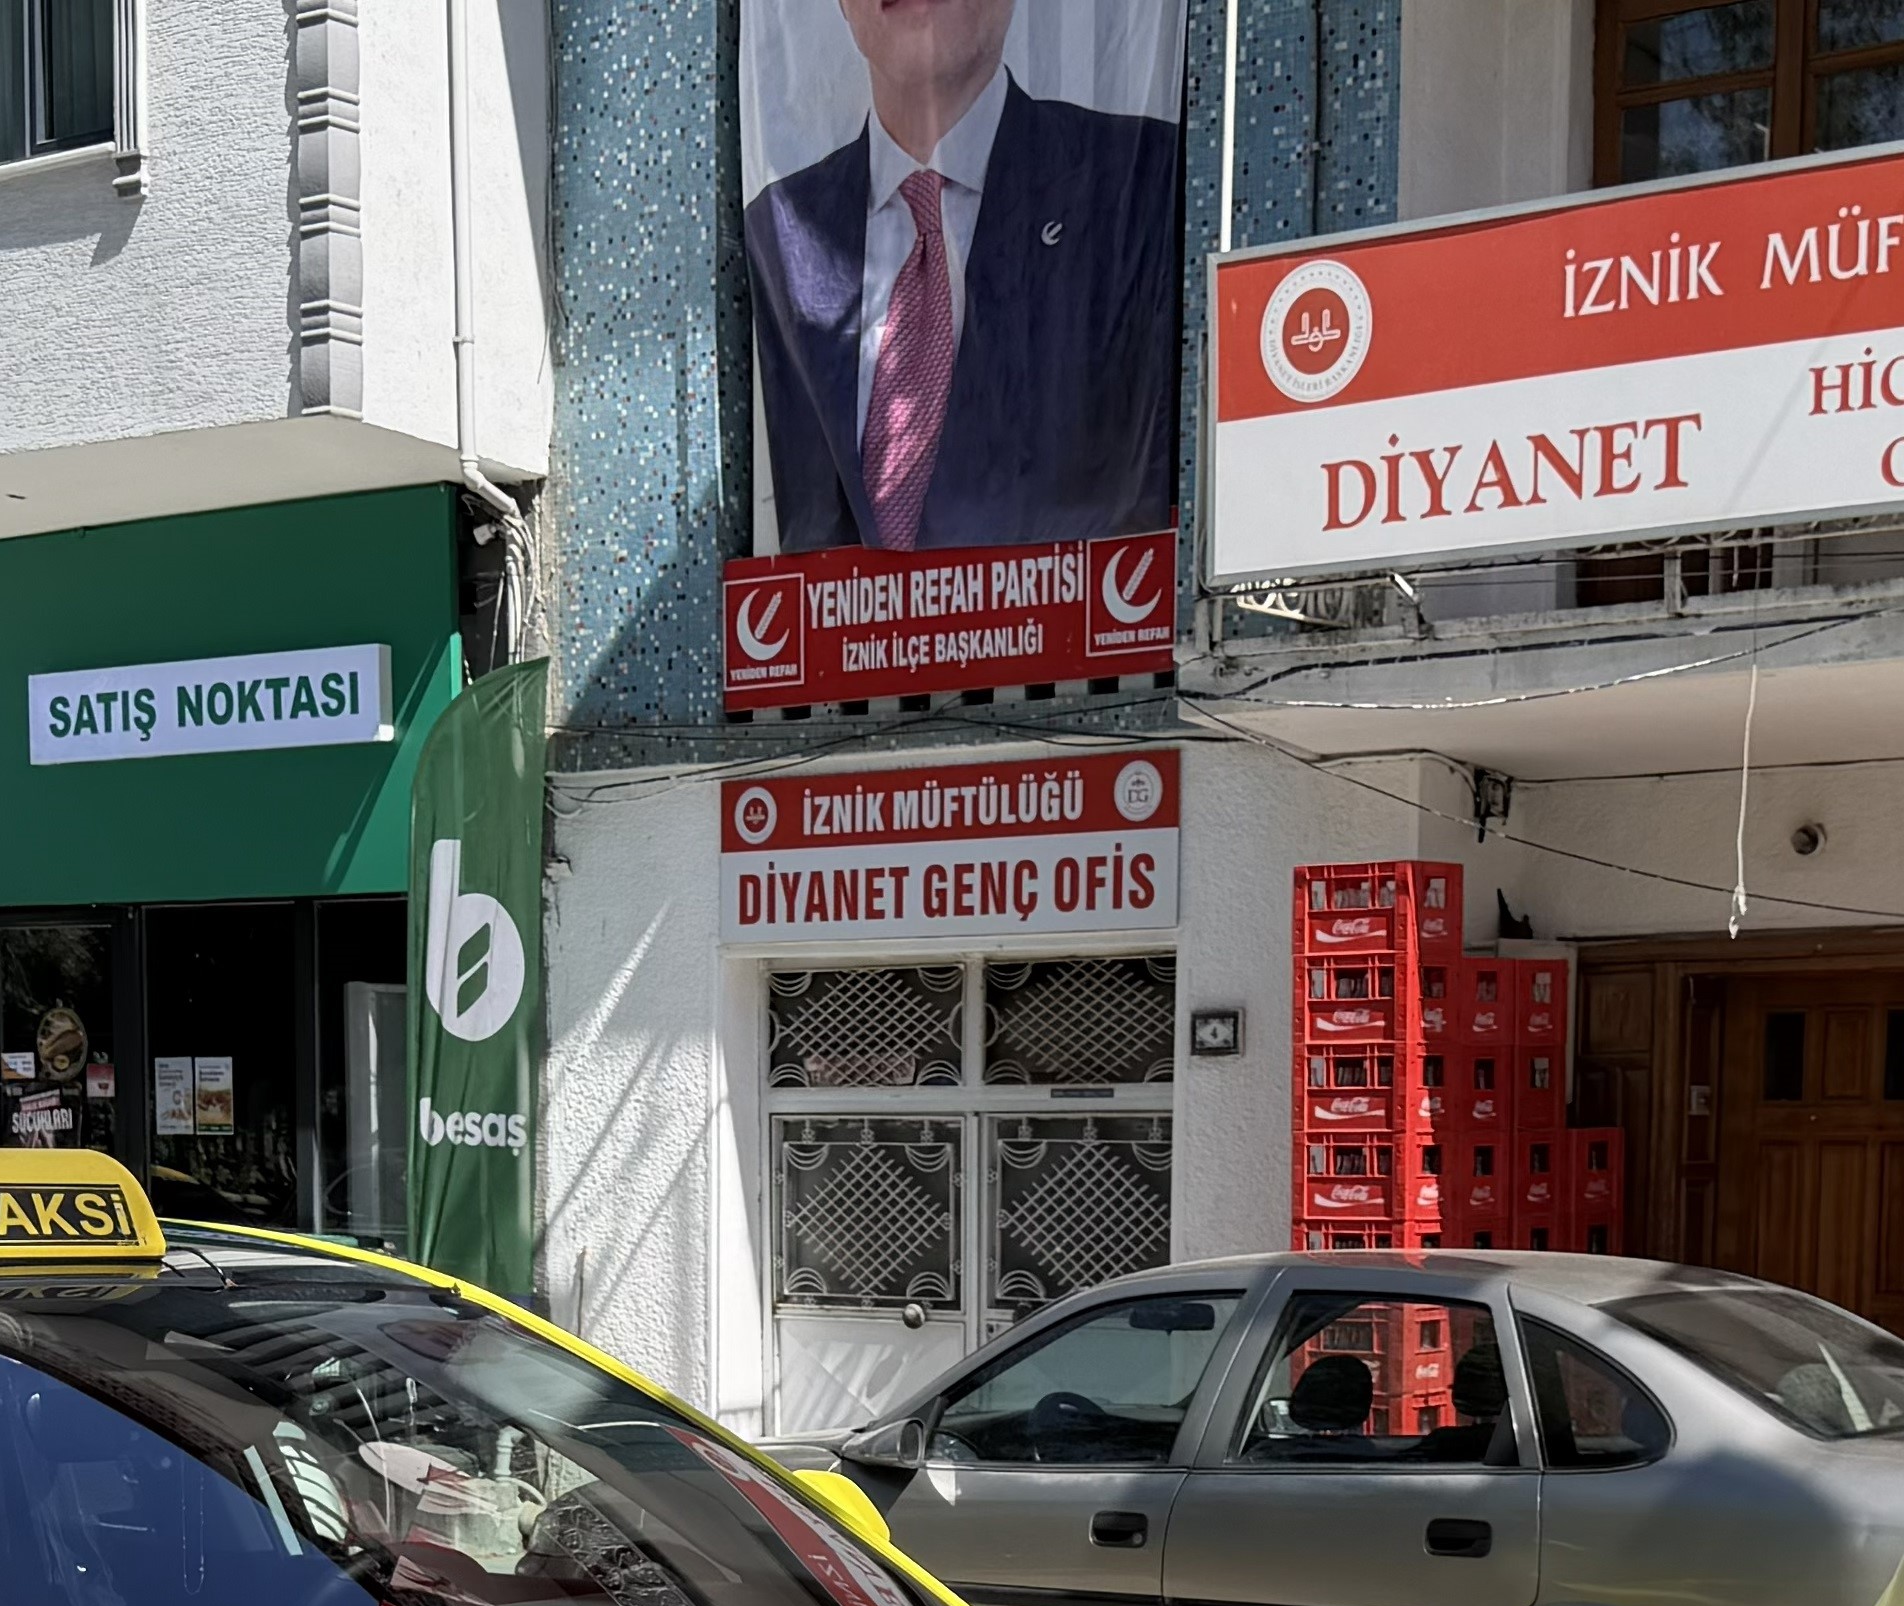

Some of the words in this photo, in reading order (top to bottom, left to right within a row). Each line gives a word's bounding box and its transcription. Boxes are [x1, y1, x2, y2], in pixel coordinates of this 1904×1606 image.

[1562, 229, 1722, 320] İZNİK
[1321, 412, 1703, 531] DİYANET
[806, 567, 903, 629] YENİDEN
[910, 558, 984, 619] REFAH
[991, 539, 1085, 609] PARTİSİ
[842, 635, 888, 672] İZNİK
[892, 631, 931, 673] İLÇE
[934, 618, 1043, 670] BAŞKANLIĞI
[47, 691, 157, 743] SATIŞ
[175, 670, 360, 727] NOKTASI
[802, 785, 885, 836] İZNİK
[893, 770, 1084, 832] MÜFTÜLÜĞÜ
[739, 862, 909, 925] DİYANET
[923, 859, 1038, 921] GENÇ
[1054, 842, 1156, 912] OFİS
[419, 1097, 528, 1156] besaş
